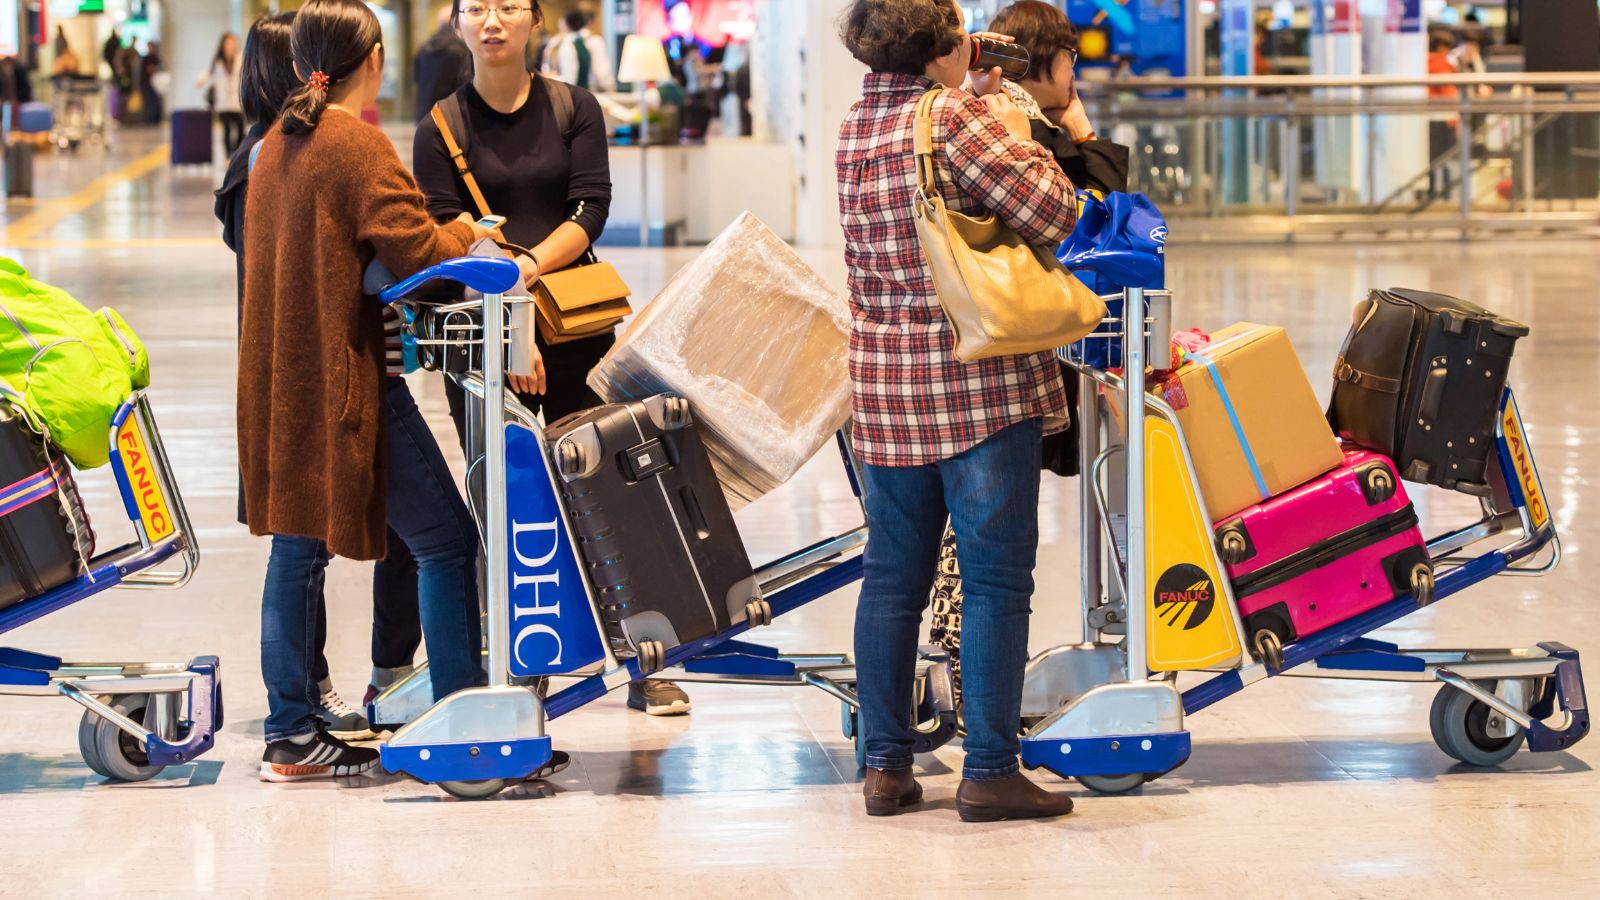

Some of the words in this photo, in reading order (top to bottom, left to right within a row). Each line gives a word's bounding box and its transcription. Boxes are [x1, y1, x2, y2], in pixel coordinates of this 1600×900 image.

[121, 431, 166, 534] FANUC
[1505, 417, 1543, 521] FANUC
[512, 516, 562, 668] DHC
[1159, 590, 1209, 603] FANUC
